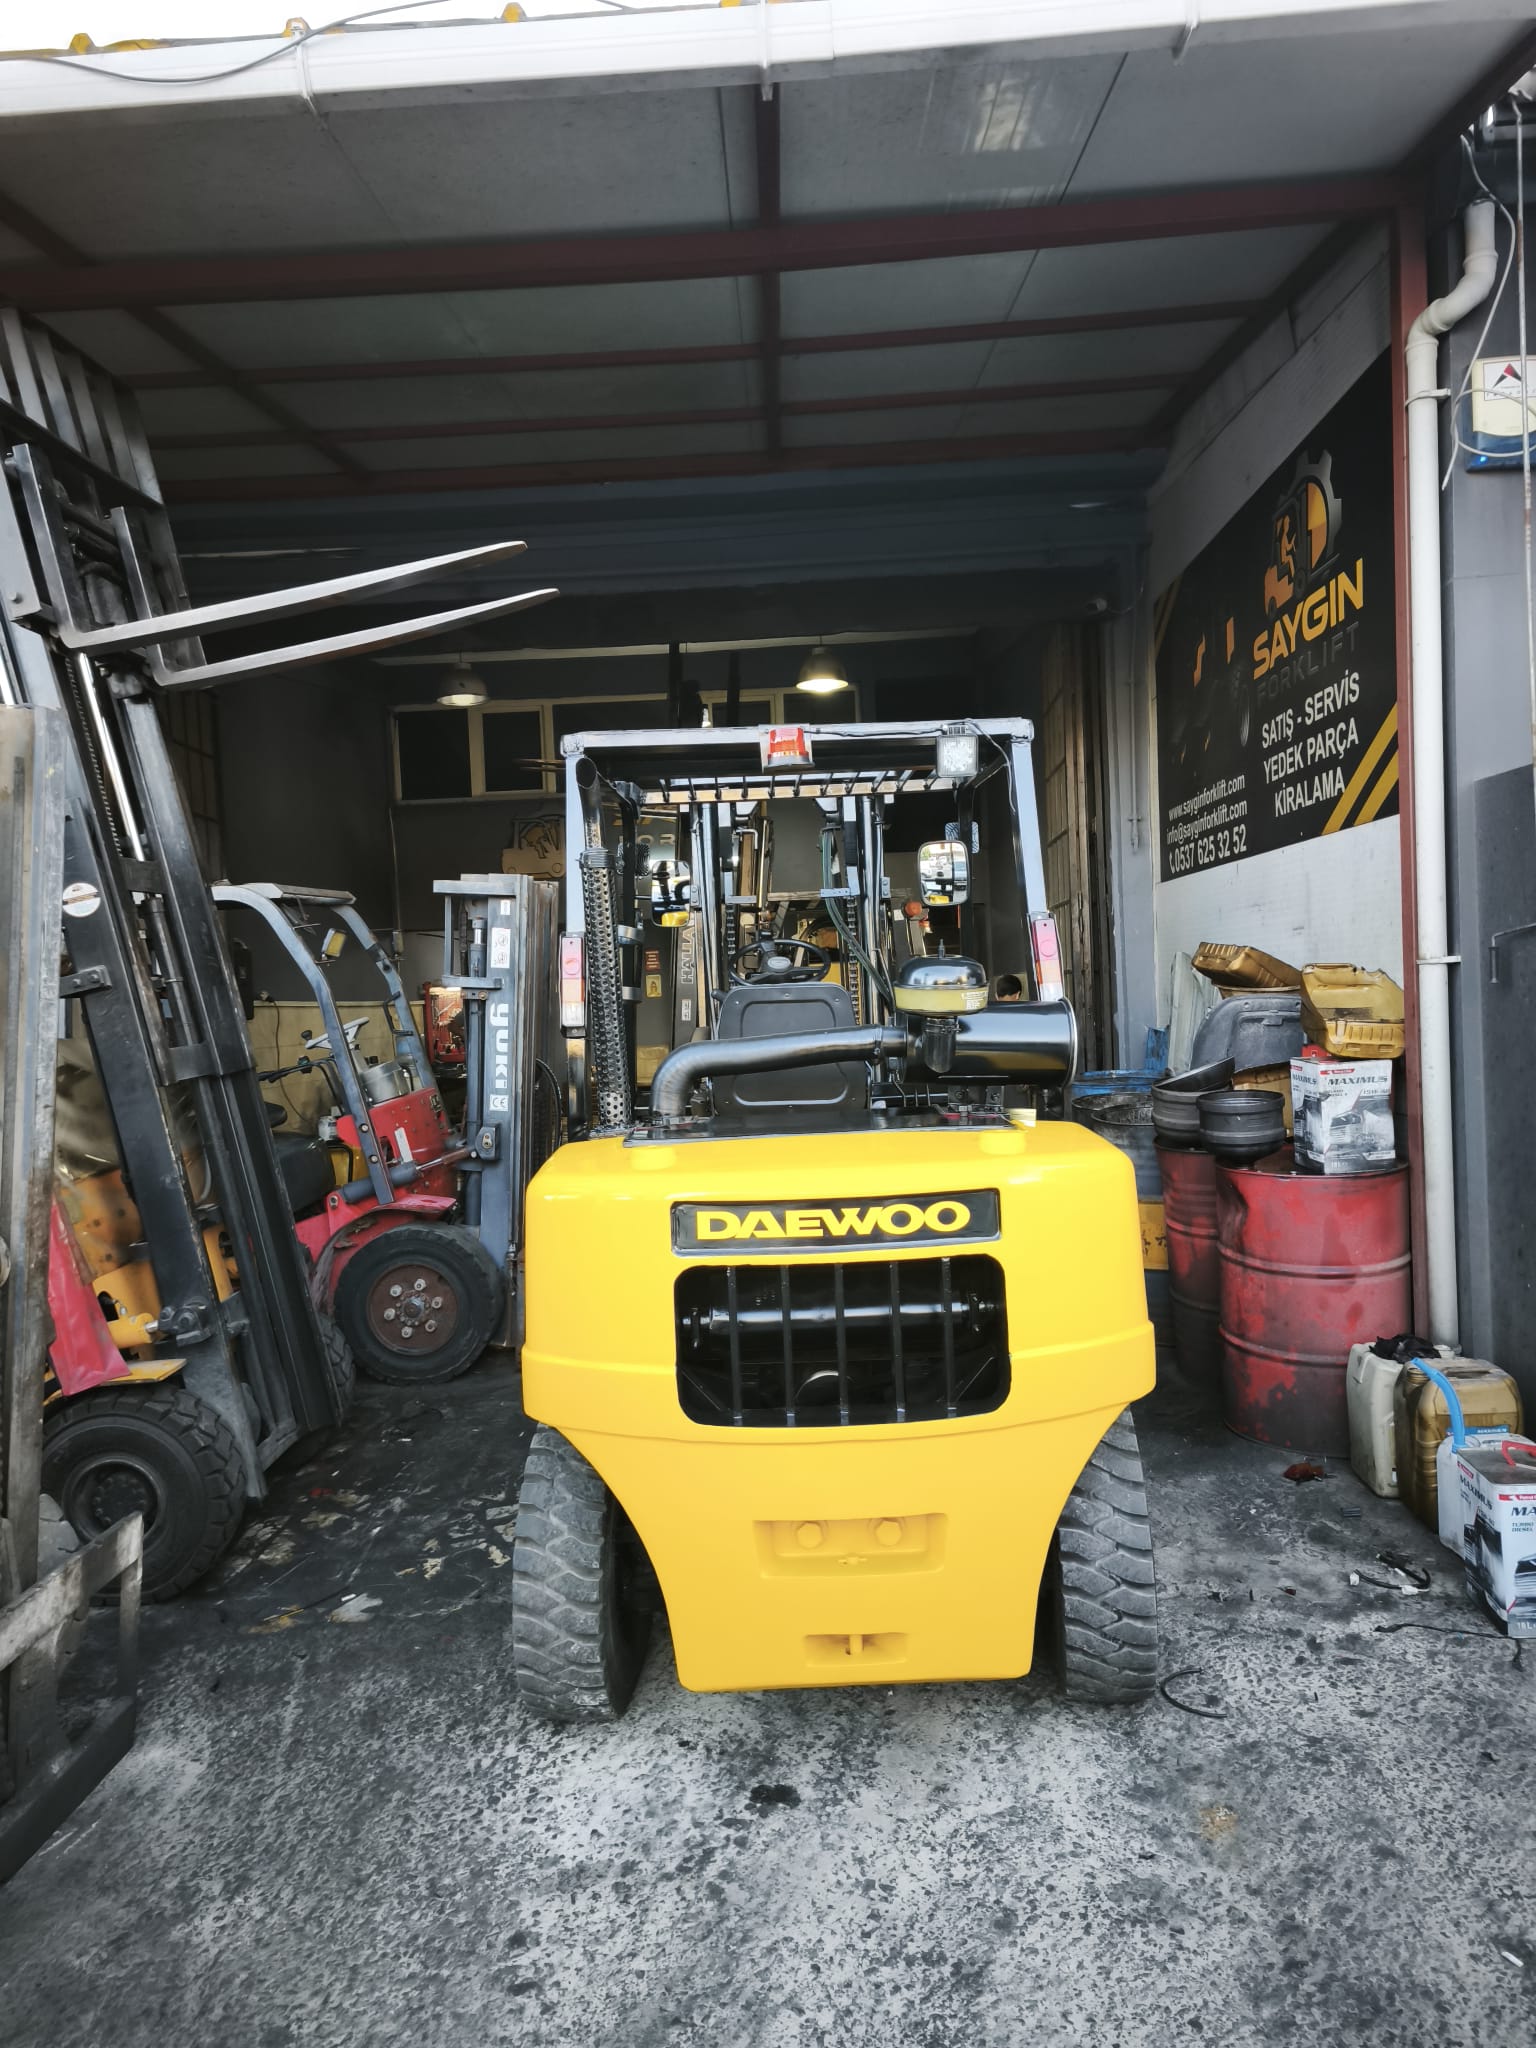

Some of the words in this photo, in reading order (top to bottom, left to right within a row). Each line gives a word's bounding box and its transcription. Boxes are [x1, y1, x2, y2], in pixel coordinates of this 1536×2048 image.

[1253, 558, 1364, 680] SAYGIN
[1257, 621, 1359, 705] FORKLIFT
[1261, 708, 1294, 749] SATIŞ
[1304, 669, 1360, 726] SERVİS
[1263, 742, 1304, 785] YEDEK
[1307, 717, 1359, 763] PARÇA
[1168, 774, 1246, 822] www.sayginforklift.com
[1274, 766, 1345, 818] KİRALAMA
[1166, 800, 1248, 845] info@sayginforklift.com
[1174, 842, 1195, 873] 0537
[1197, 835, 1216, 865] 625
[1217, 830, 1231, 859] 32
[1233, 824, 1247, 854] 52
[696, 1200, 971, 1240] DAEWOO
